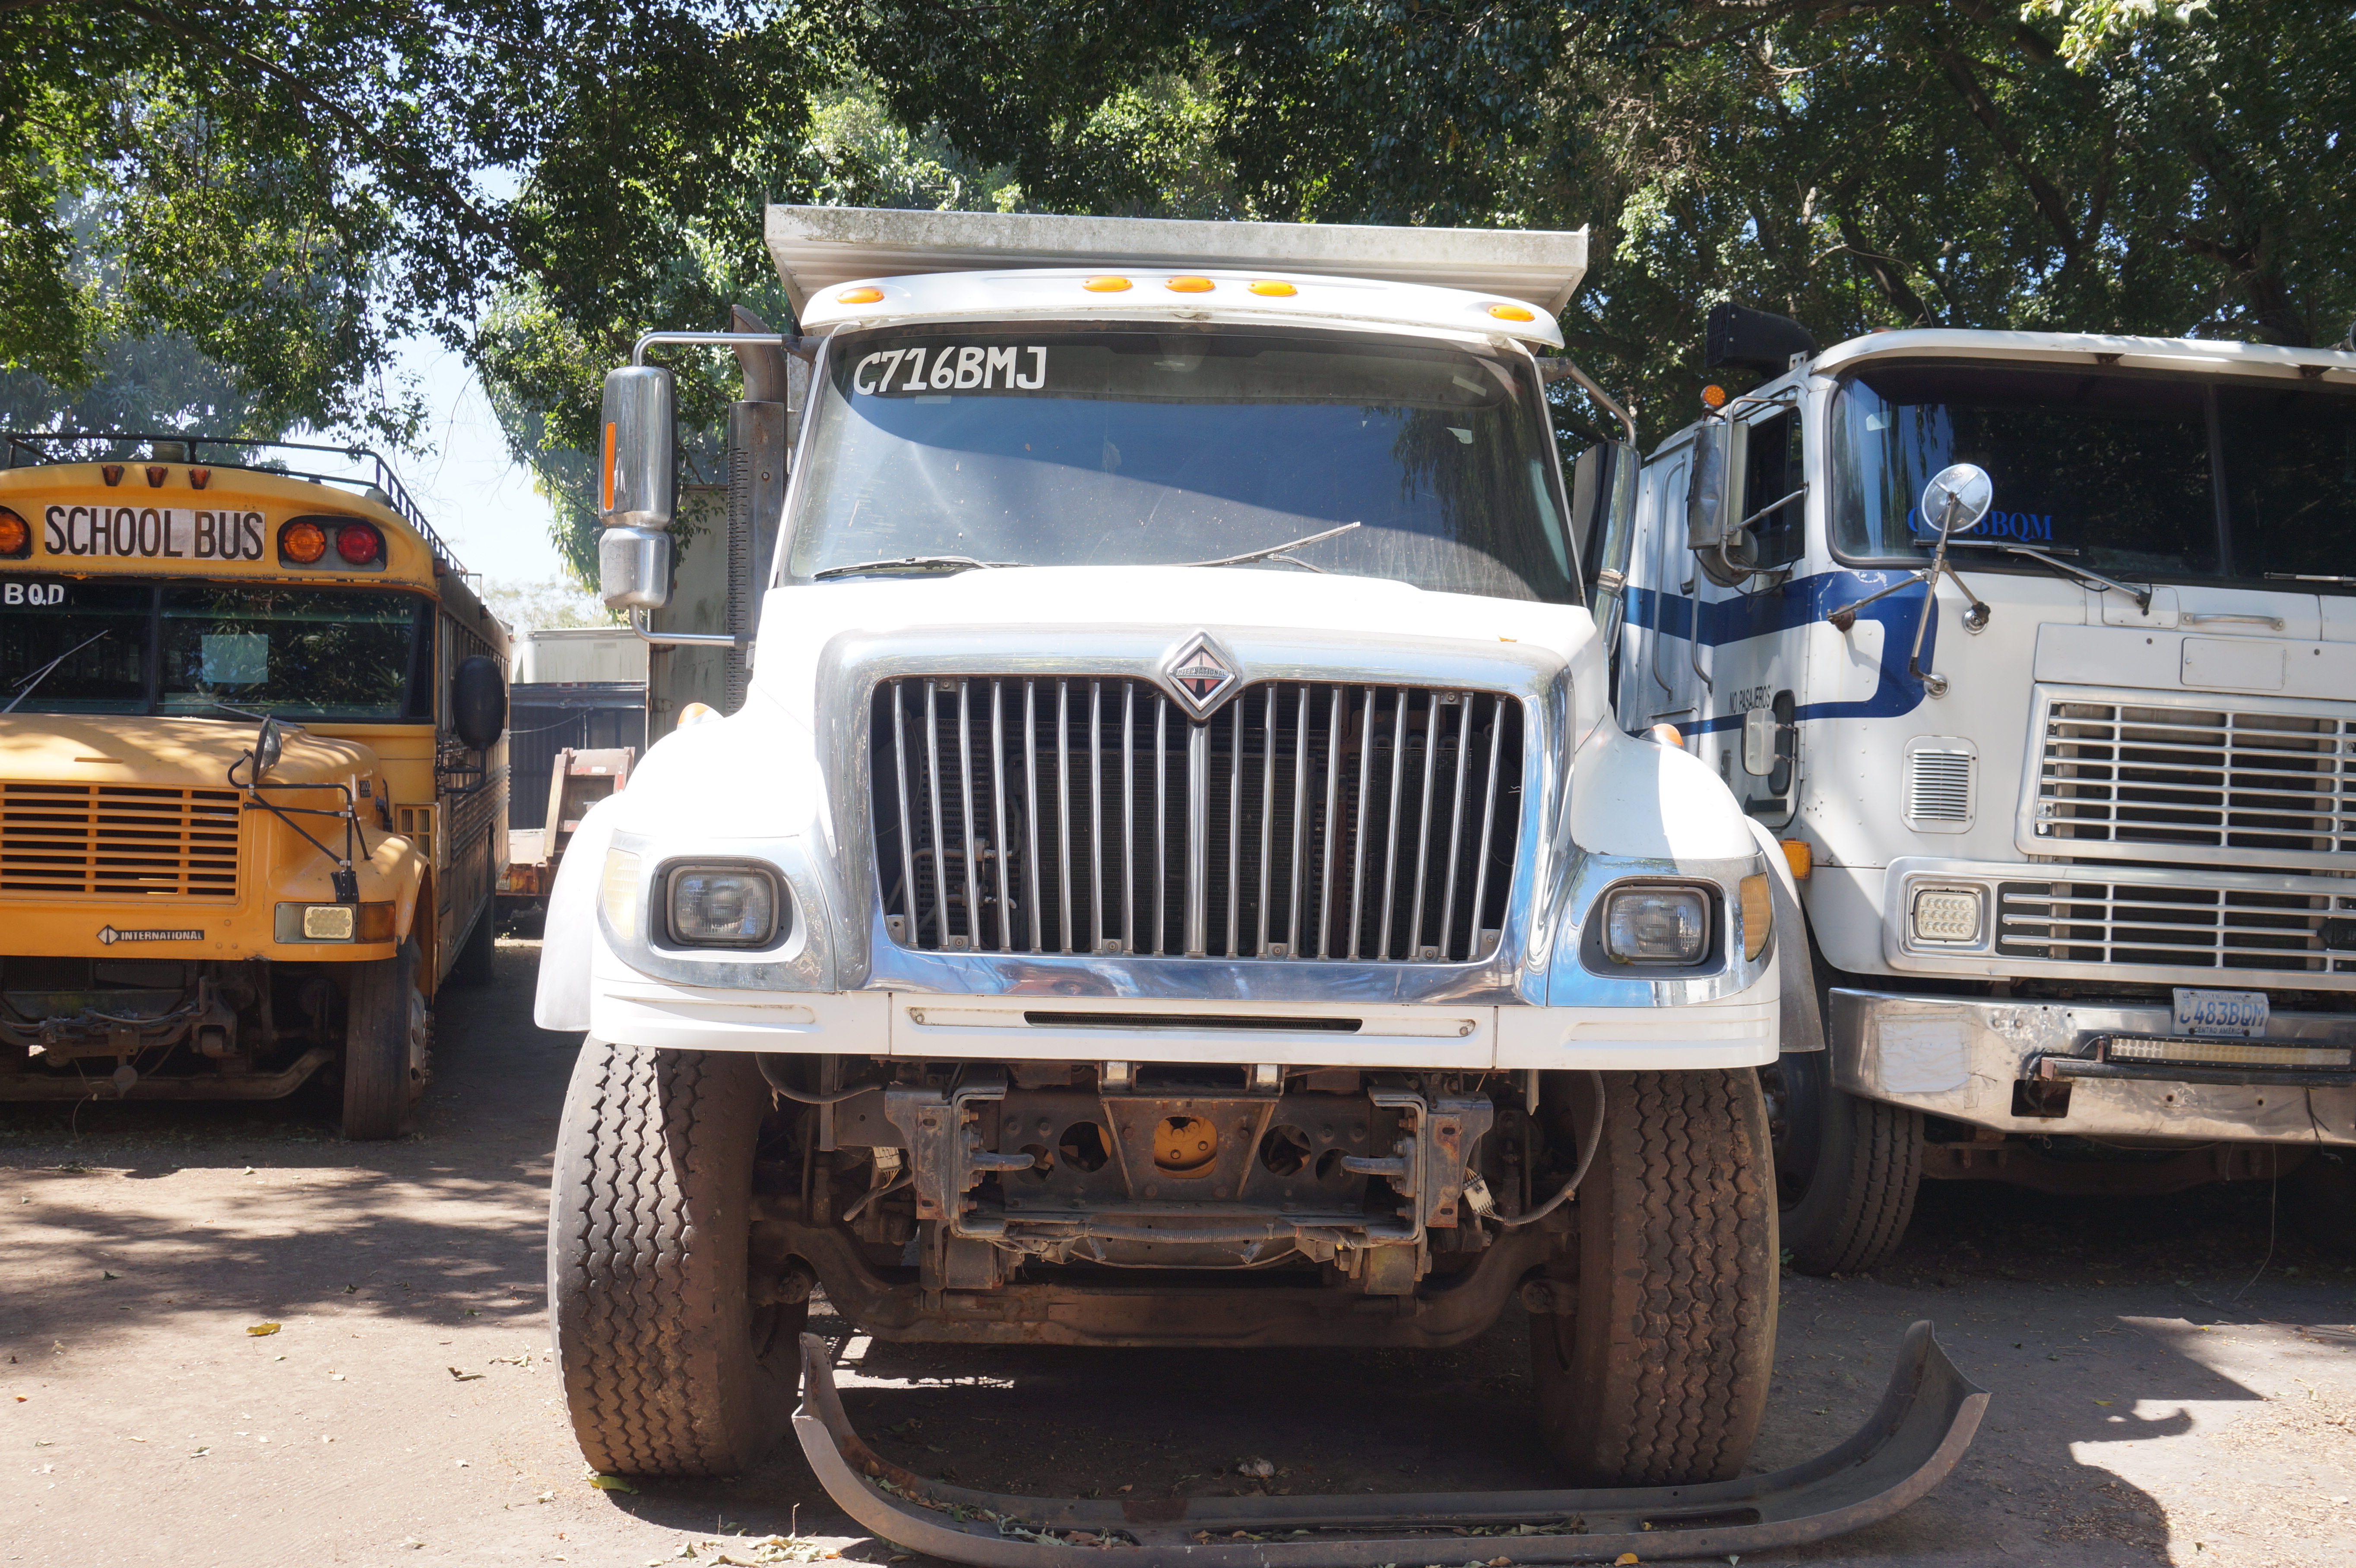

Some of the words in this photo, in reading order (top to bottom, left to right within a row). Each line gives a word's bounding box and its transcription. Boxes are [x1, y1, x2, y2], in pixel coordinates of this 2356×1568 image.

[854, 347, 1046, 395] C716BMJ
[44, 505, 183, 557] SCHOOL
[194, 511, 263, 560] BUS
[1176, 667, 1226, 676] INTERNATIONAL
[1729, 691, 1737, 714] NO
[121, 930, 203, 940] INTERNATIONAL
[2179, 999, 2265, 1027] C483BQM
